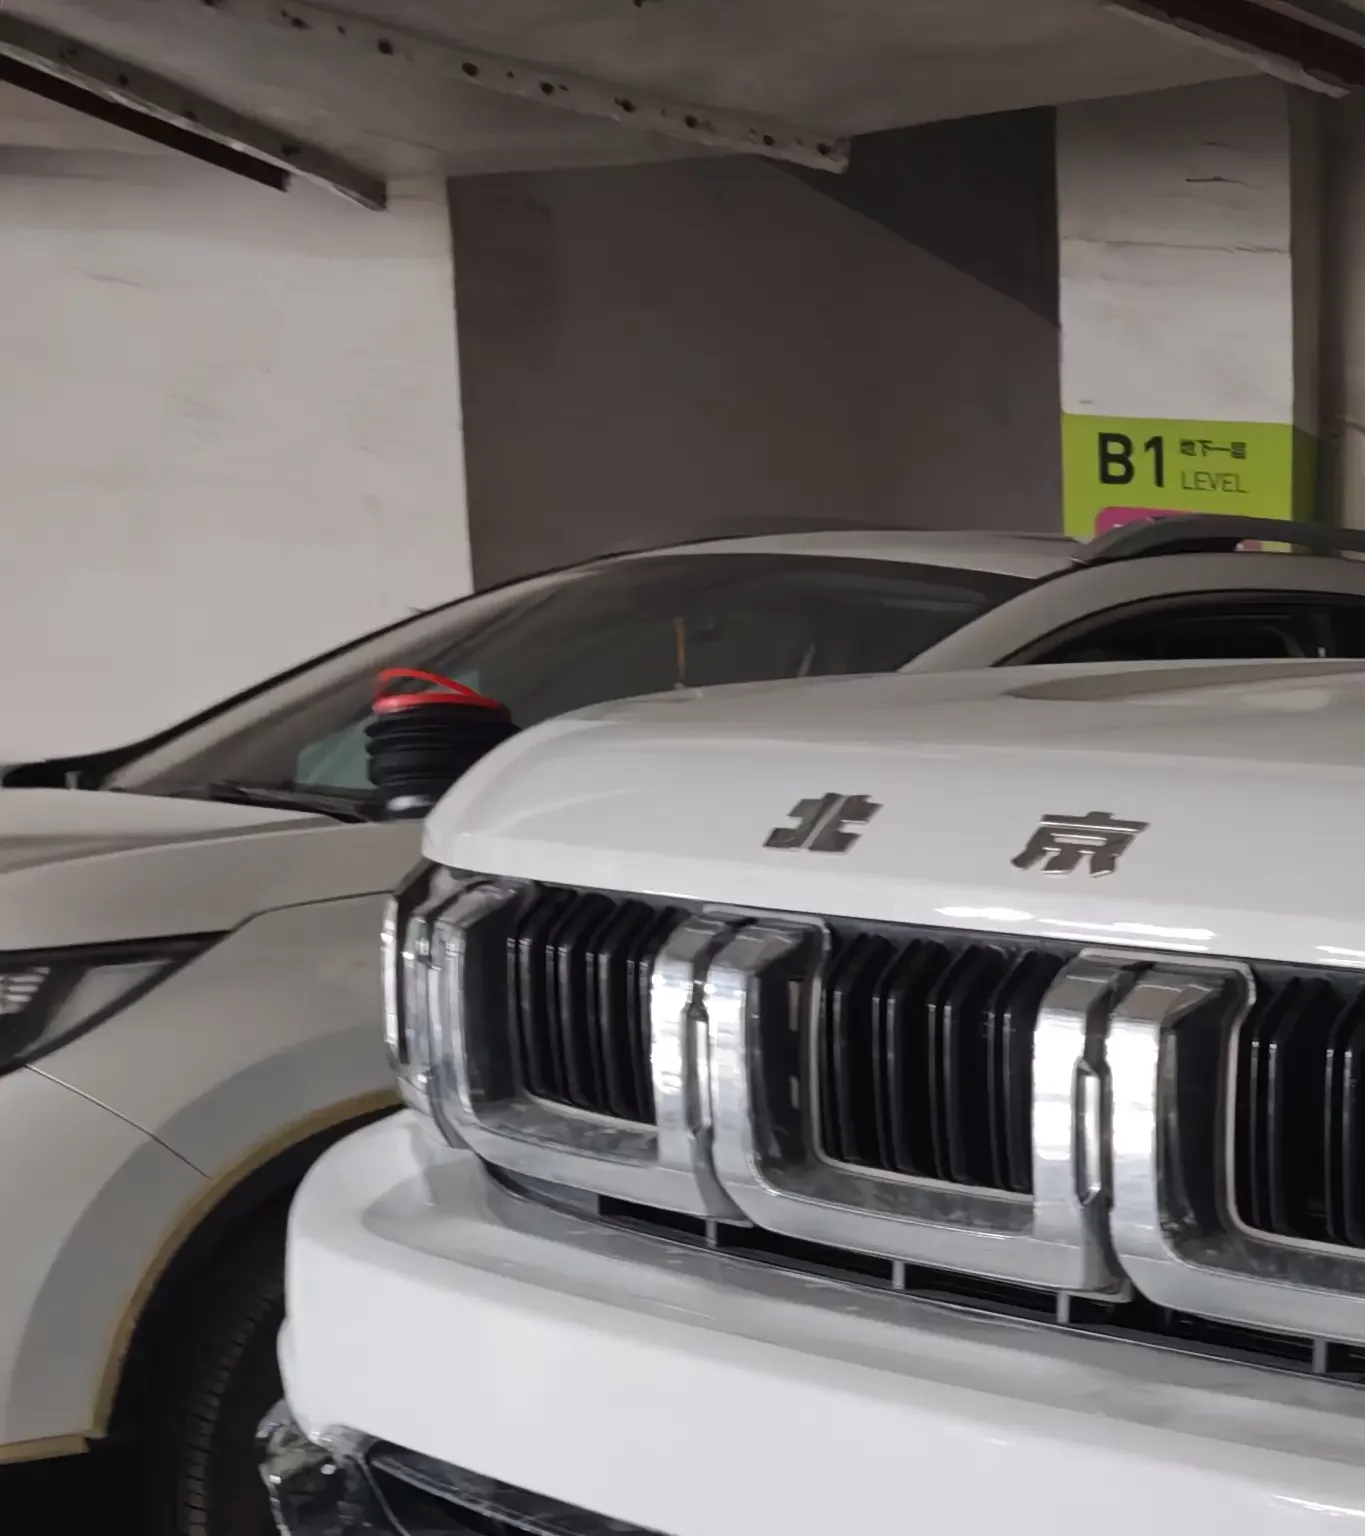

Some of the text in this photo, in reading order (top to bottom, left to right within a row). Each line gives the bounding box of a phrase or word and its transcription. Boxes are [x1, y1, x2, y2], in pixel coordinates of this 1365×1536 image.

[1098, 432, 1165, 488] B1
[1181, 471, 1249, 493] LEVEL
[763, 791, 1151, 879] 北京
